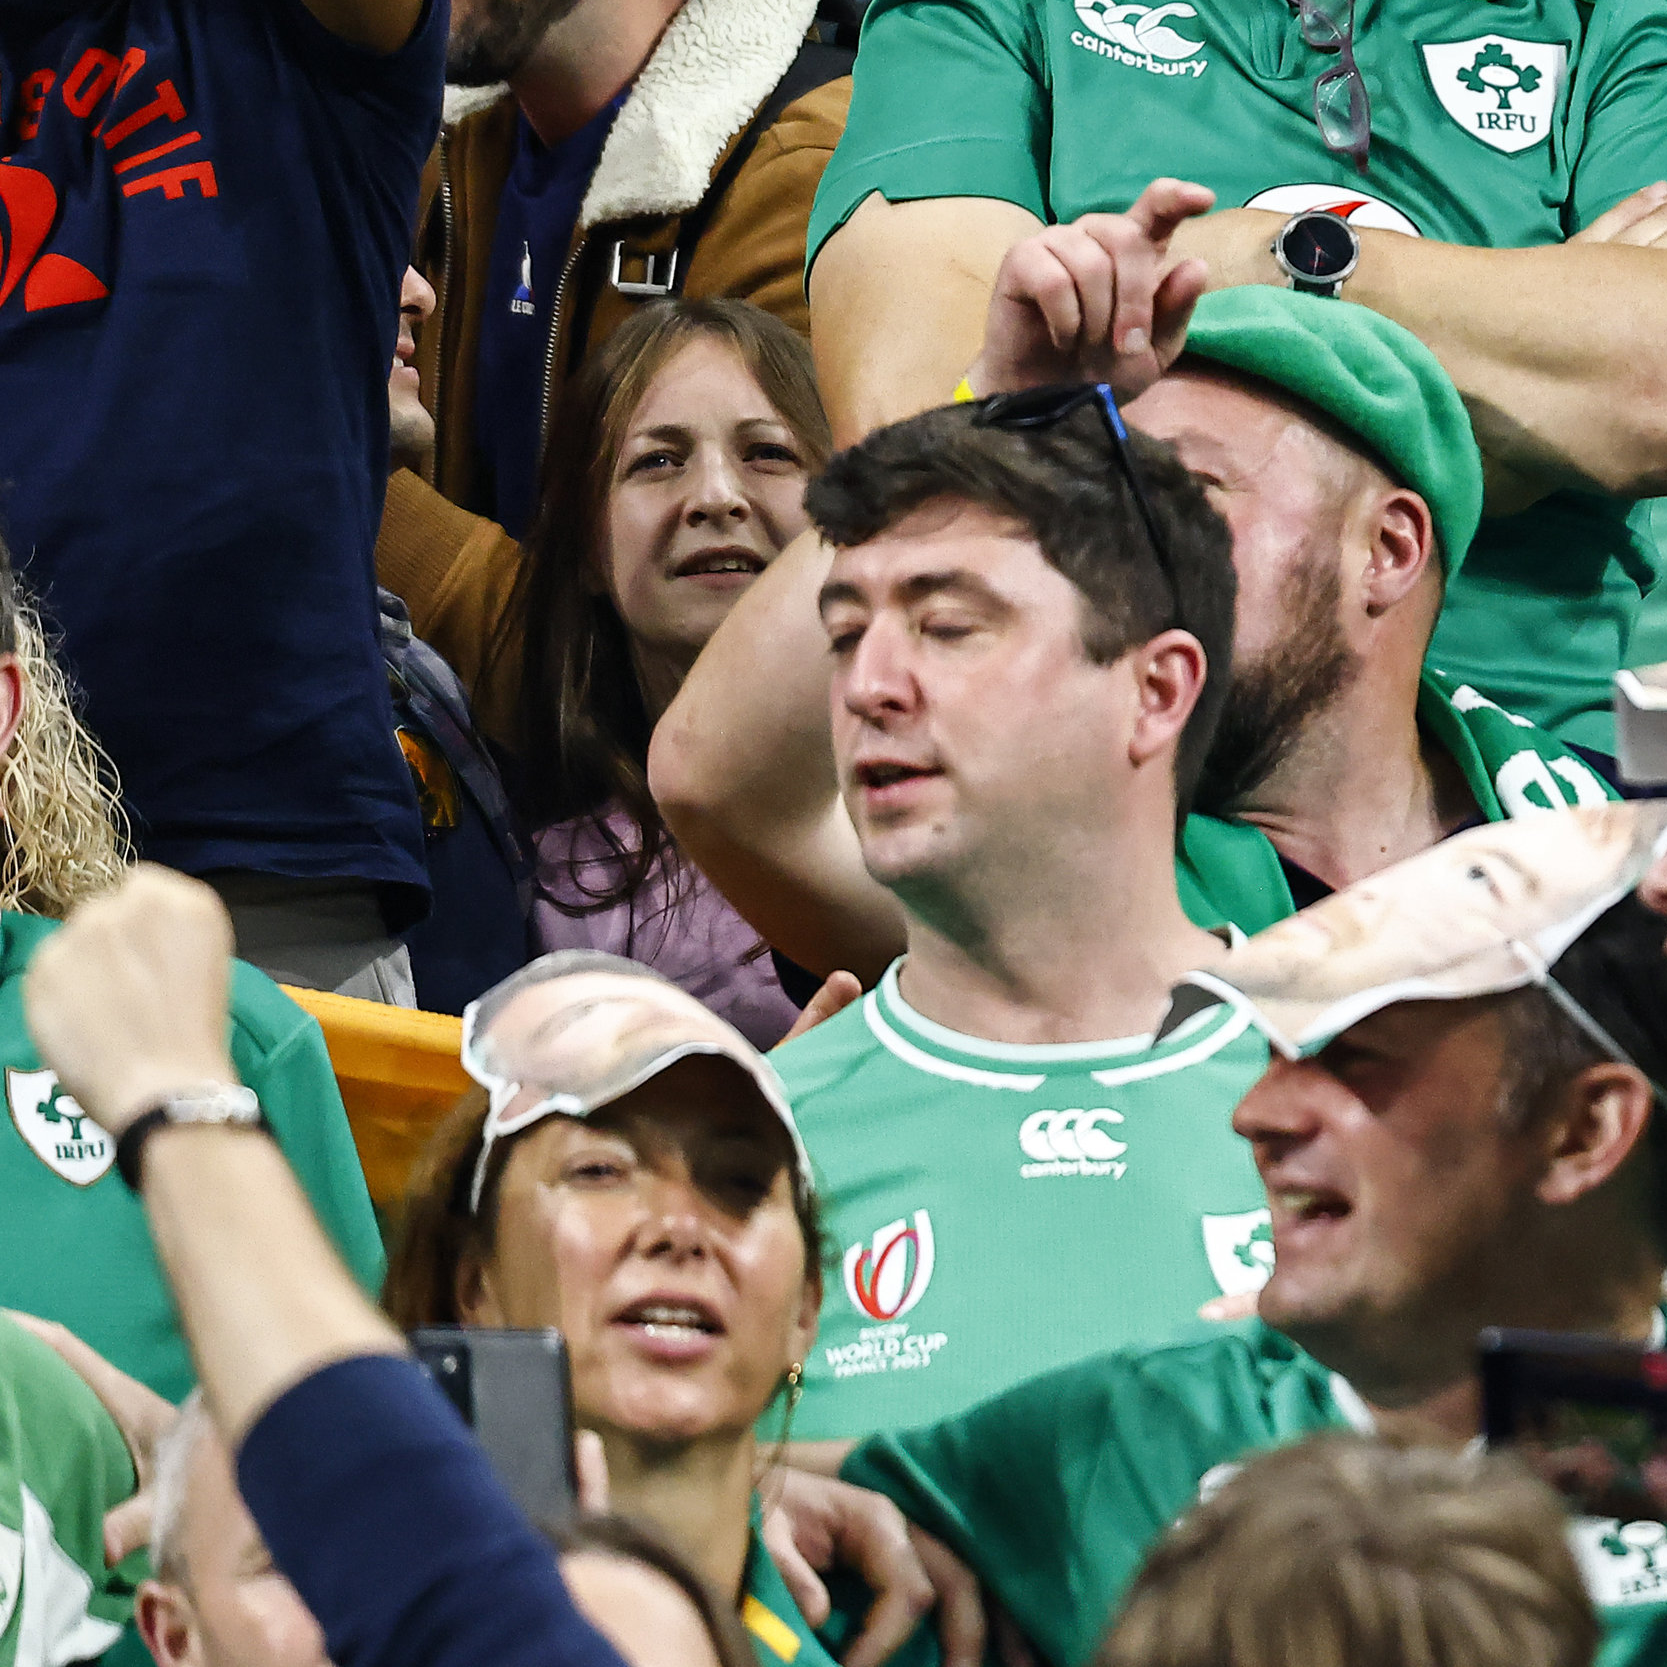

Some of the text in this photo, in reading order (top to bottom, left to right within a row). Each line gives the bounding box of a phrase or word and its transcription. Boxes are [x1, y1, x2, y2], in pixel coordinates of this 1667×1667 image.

[1070, 30, 1208, 78] canterbury
[1475, 112, 1537, 133] IRFU
[55, 1139, 106, 1162] IRFU
[1020, 1157, 1128, 1181] canterbury
[825, 1332, 949, 1367] WORLD CUP
